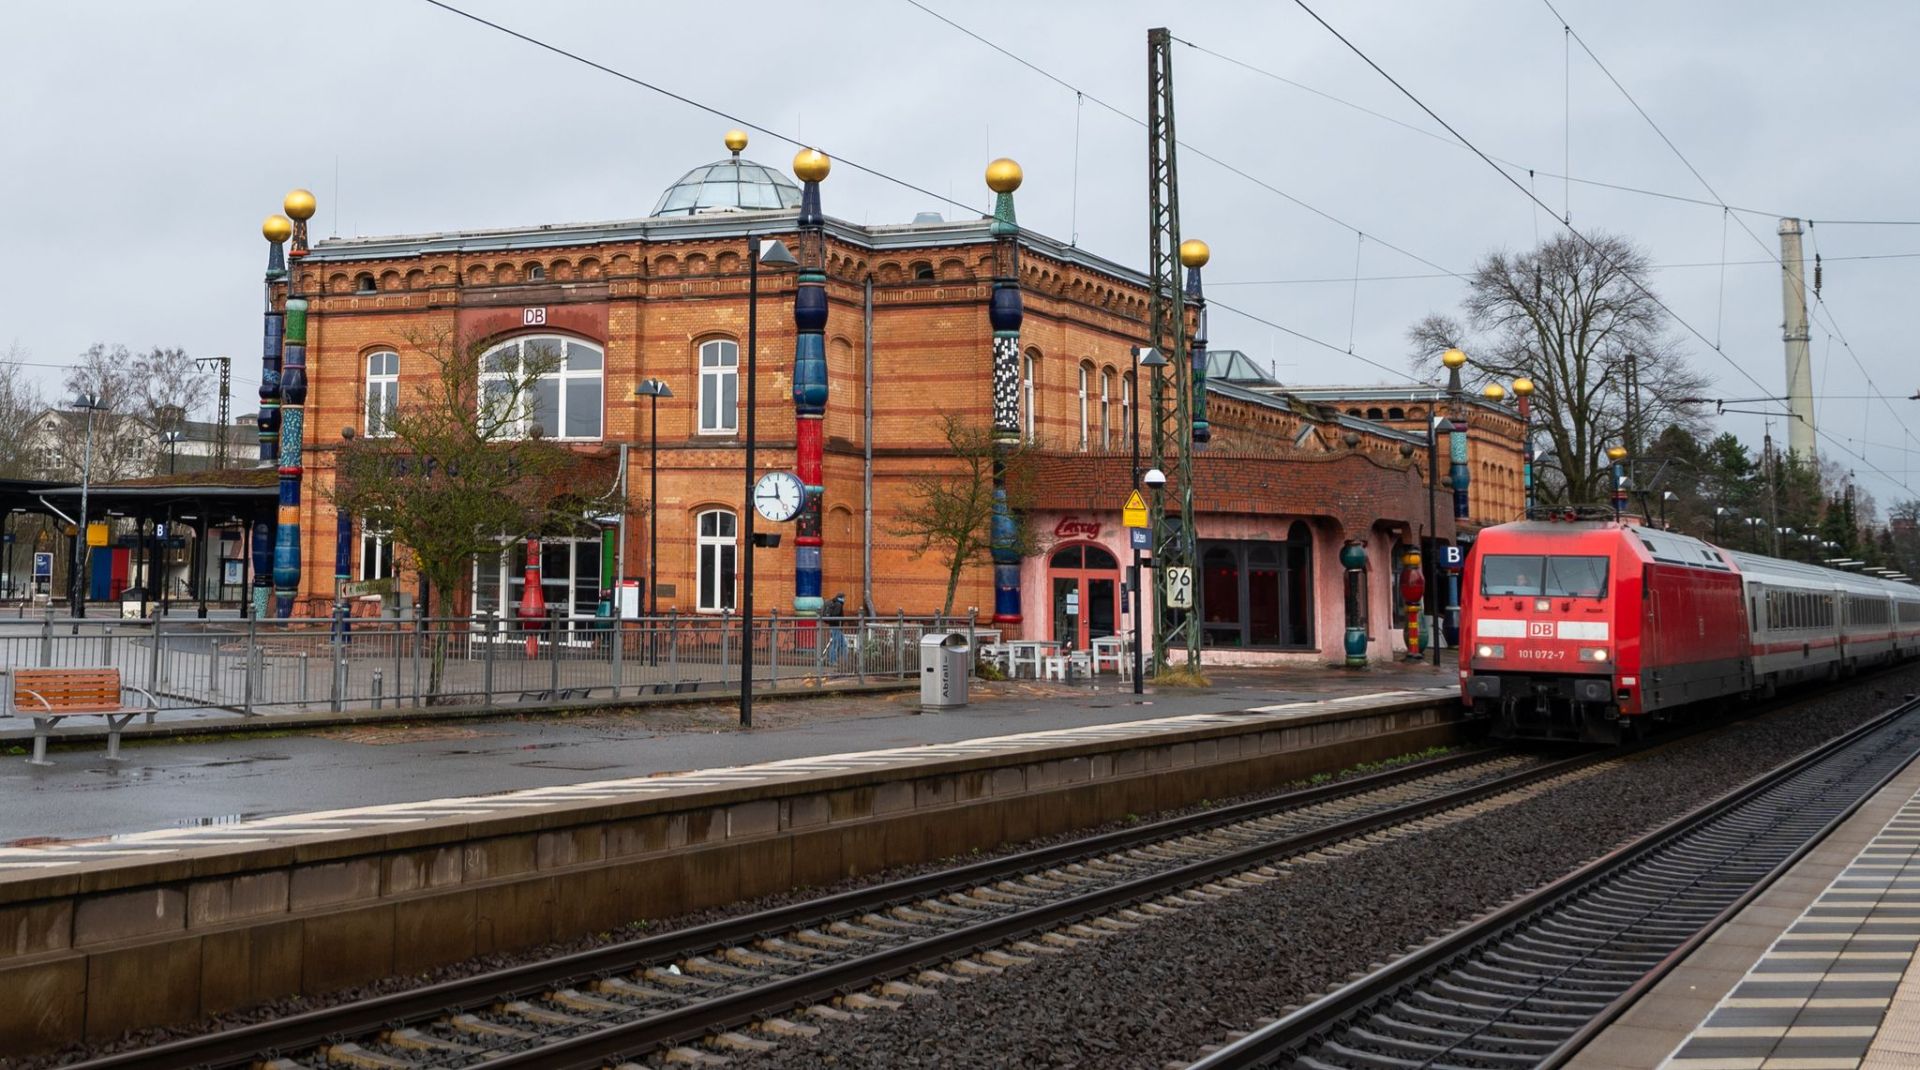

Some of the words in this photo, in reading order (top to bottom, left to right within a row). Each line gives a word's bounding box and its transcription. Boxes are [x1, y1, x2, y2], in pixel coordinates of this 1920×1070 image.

[525, 308, 544, 323] DB
[157, 524, 163, 536] B
[1447, 546, 1460, 563] B
[1168, 568, 1191, 587] 96
[1174, 588, 1185, 605] 4
[1532, 624, 1553, 635] DB
[1519, 650, 1533, 659] 101
[1535, 650, 1565, 660] 072-7
[942, 664, 950, 698] Abfall
